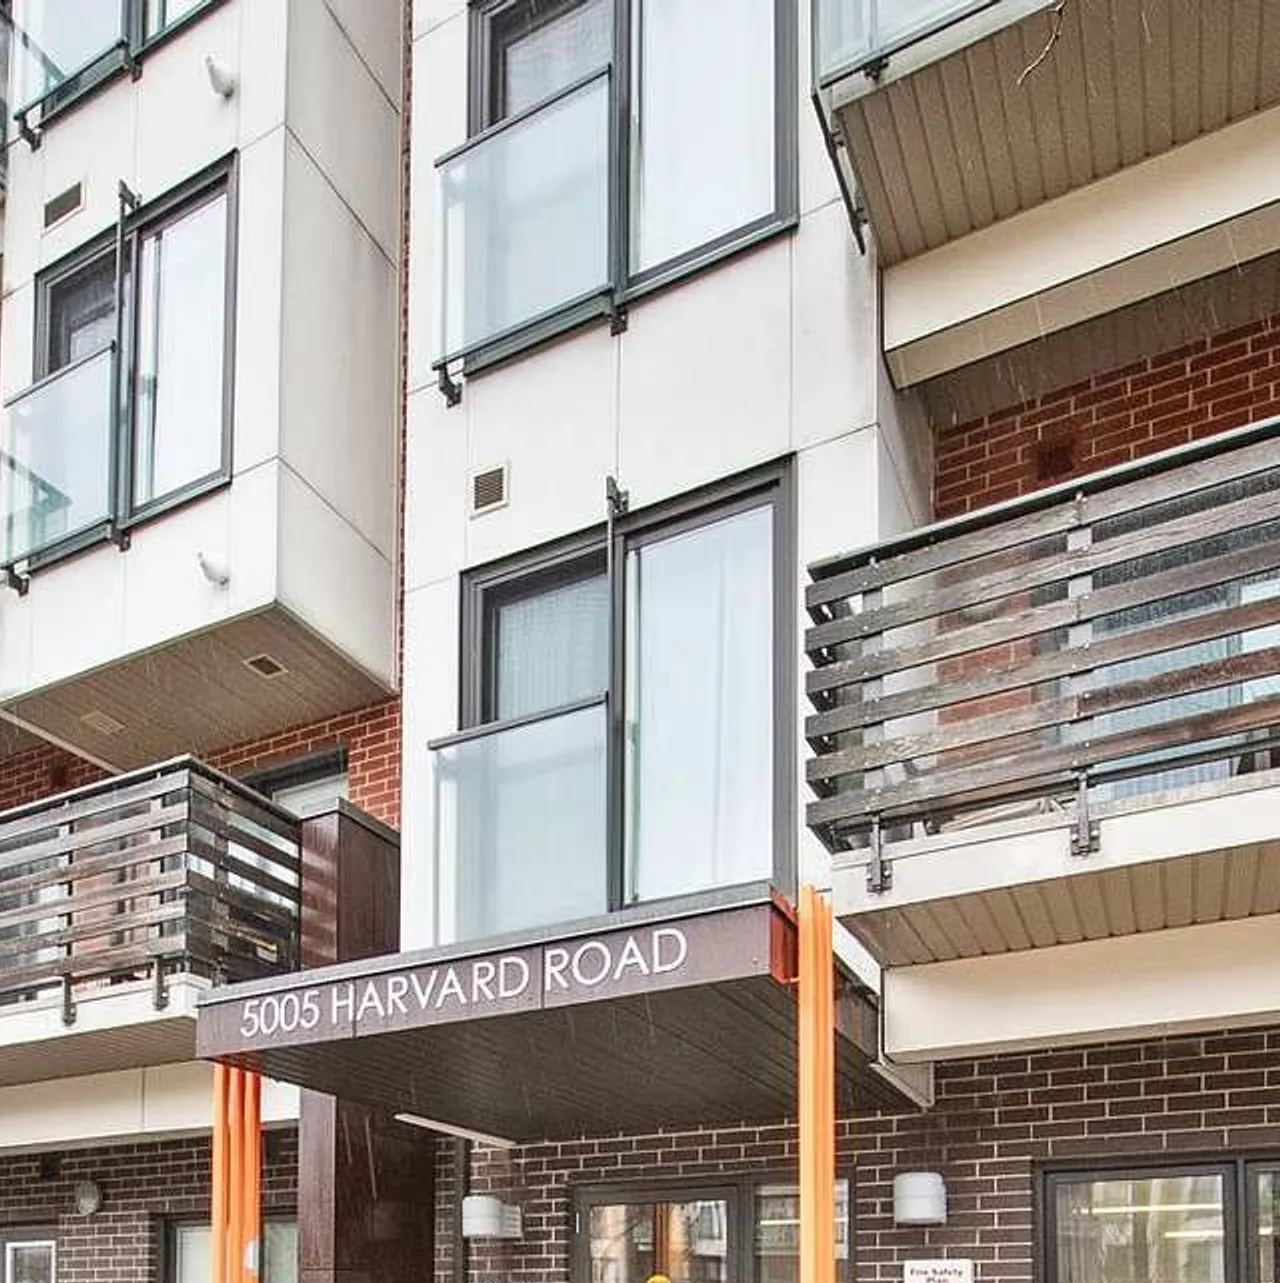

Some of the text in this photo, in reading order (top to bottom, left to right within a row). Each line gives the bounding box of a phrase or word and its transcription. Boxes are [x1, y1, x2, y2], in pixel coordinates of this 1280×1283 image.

[240, 927, 688, 1037] 5005 HARVARD ROAD
